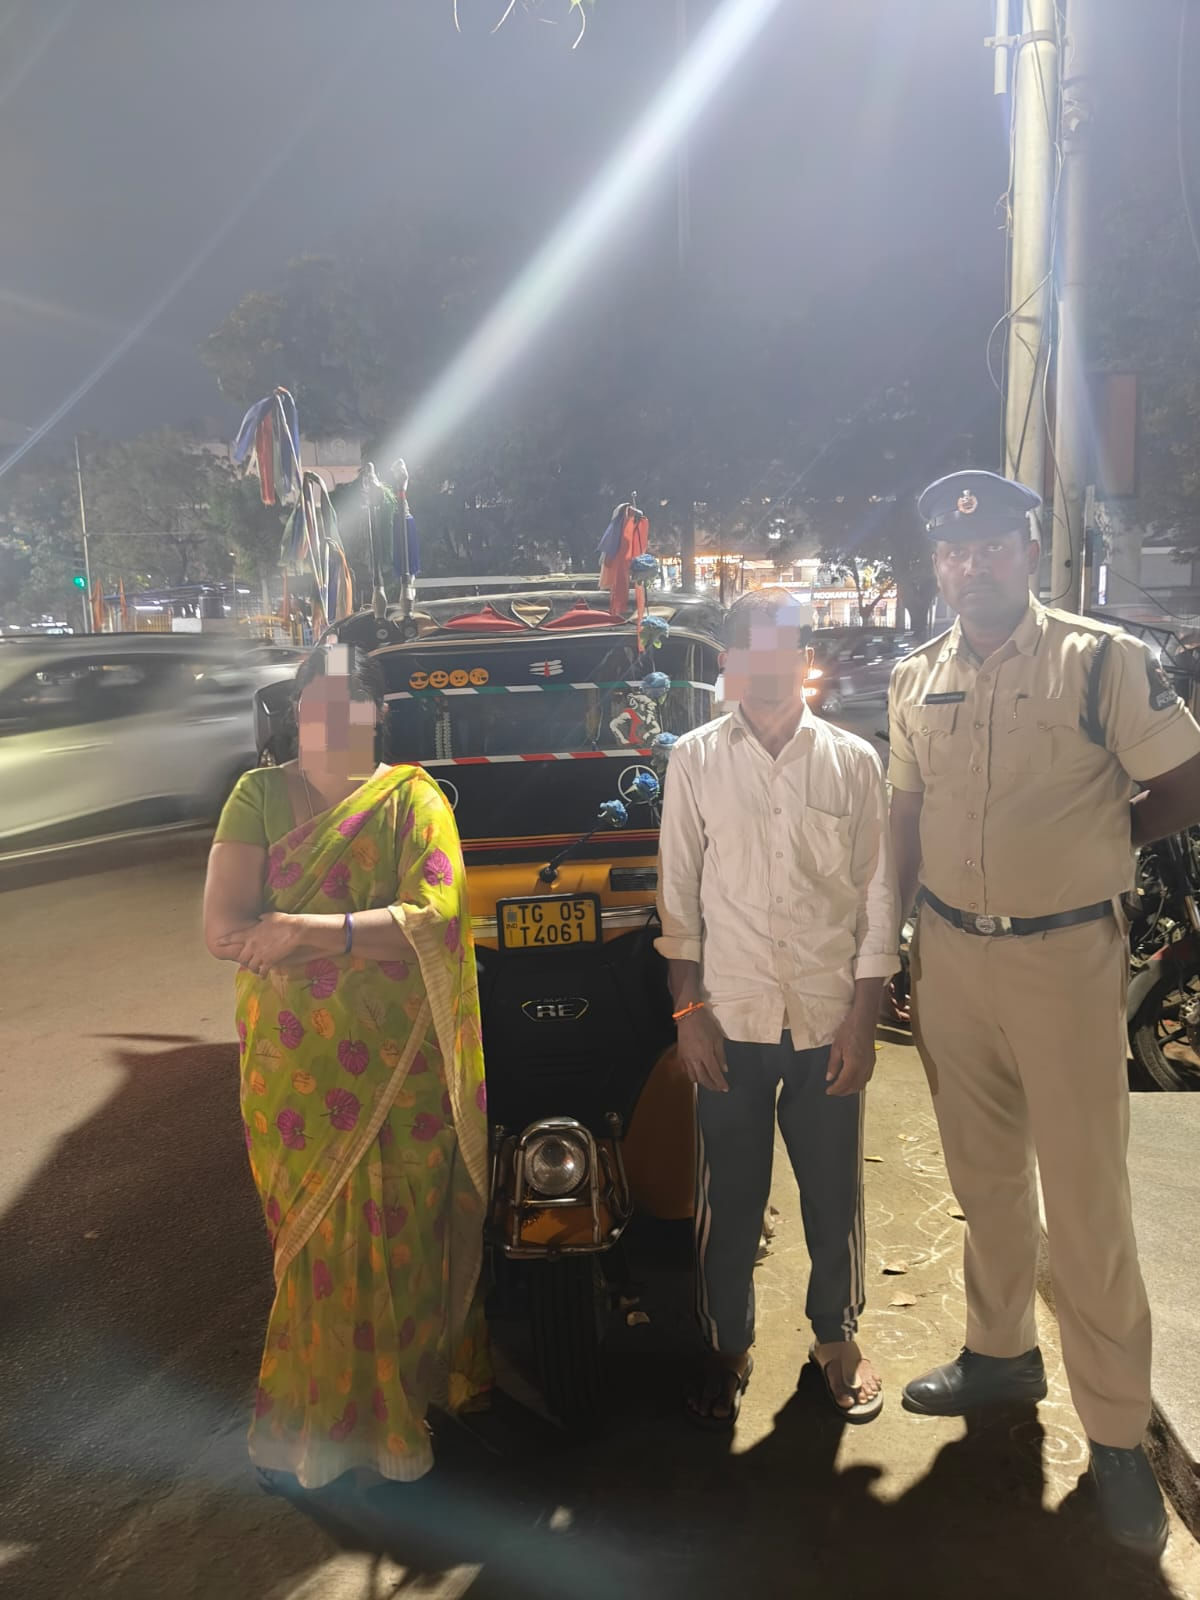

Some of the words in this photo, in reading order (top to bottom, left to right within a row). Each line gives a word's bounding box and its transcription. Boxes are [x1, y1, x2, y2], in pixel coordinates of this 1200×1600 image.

[518, 905, 543, 924] TG
[560, 902, 585, 921] 05
[520, 923, 583, 945] T4061
[537, 1005, 575, 1017] RE
